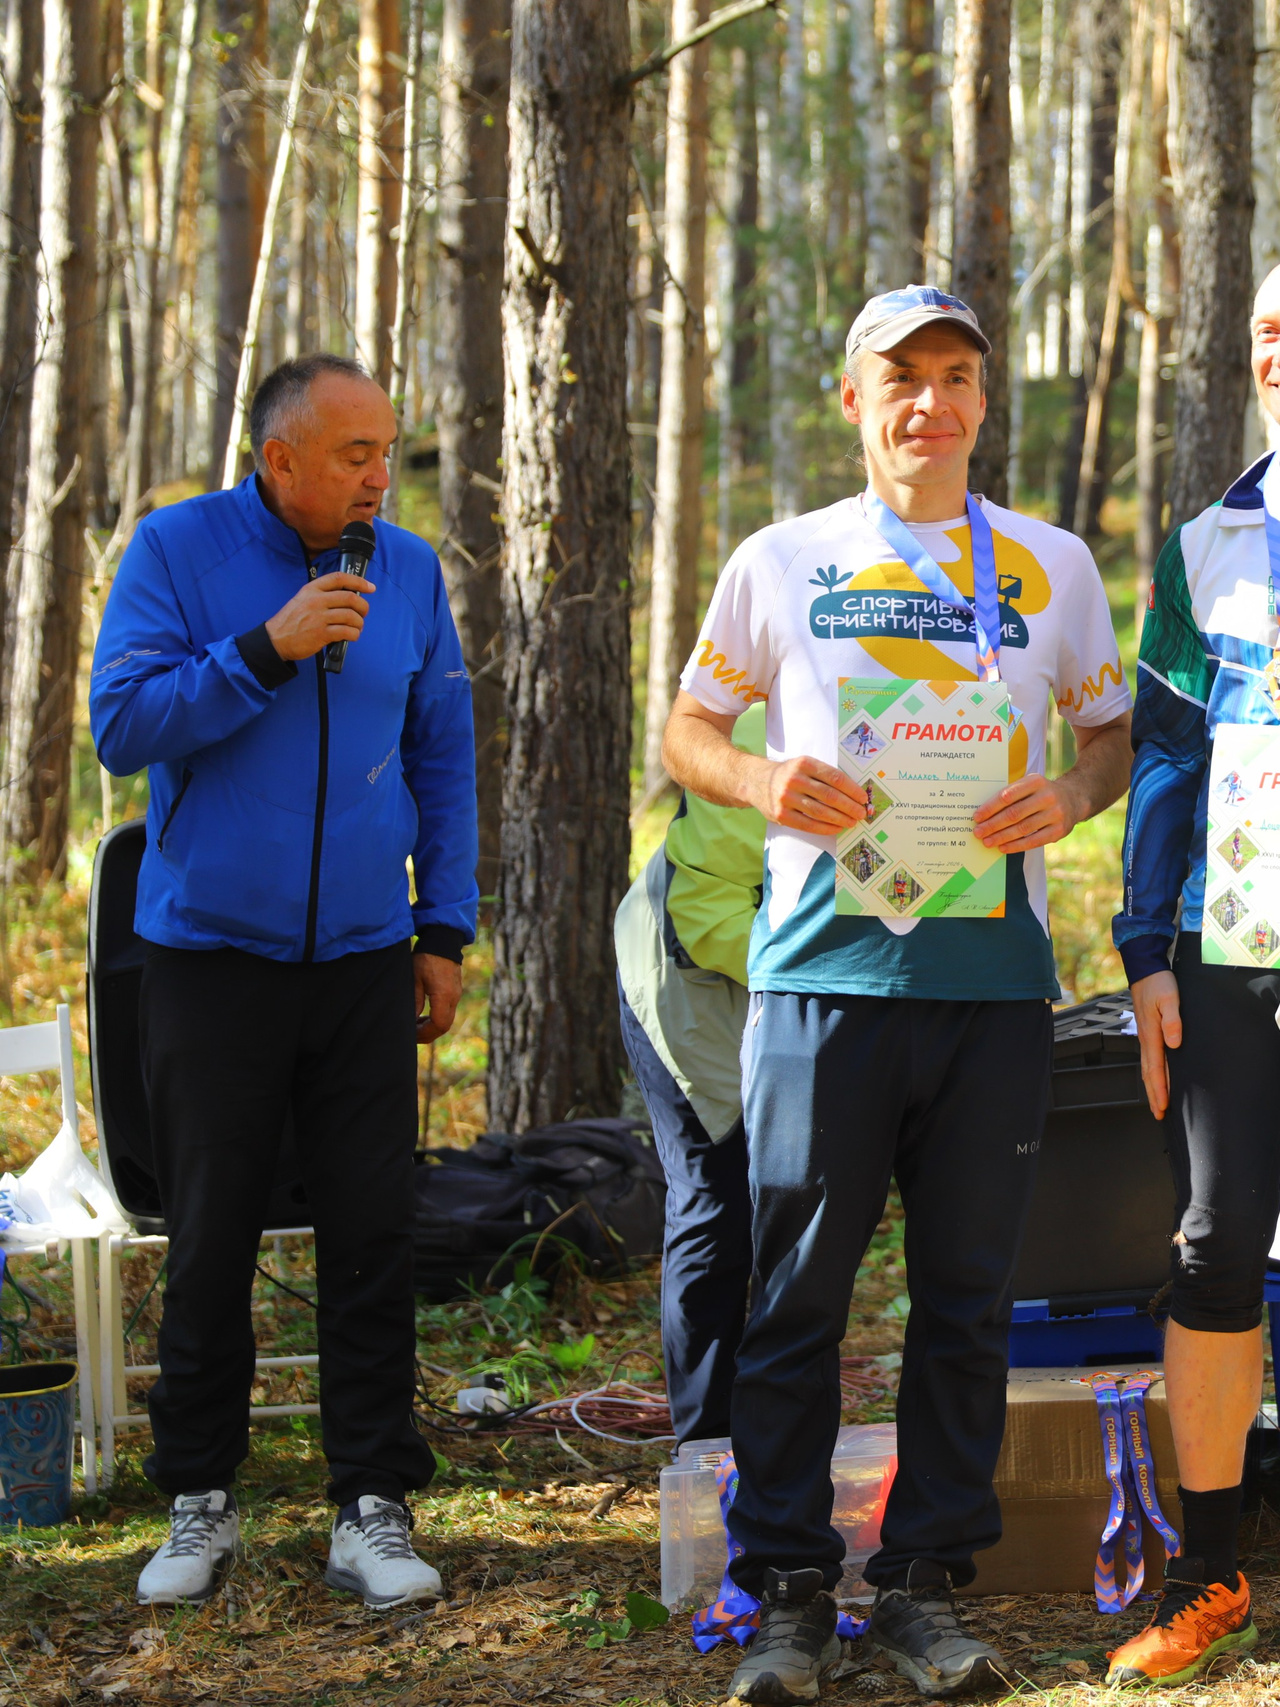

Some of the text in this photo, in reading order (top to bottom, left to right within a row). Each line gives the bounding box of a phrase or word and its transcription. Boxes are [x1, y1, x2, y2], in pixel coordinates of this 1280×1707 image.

[891, 722, 1003, 743] ГРАМОТА
[920, 751, 976, 760] НАГРАЖДАЕТСЯ
[939, 789, 945, 797] 2
[1105, 1416, 1118, 1466] ГОРНЫЙ
[1128, 1410, 1153, 1510] ГОРНЫЙ КОРОЛЬ
